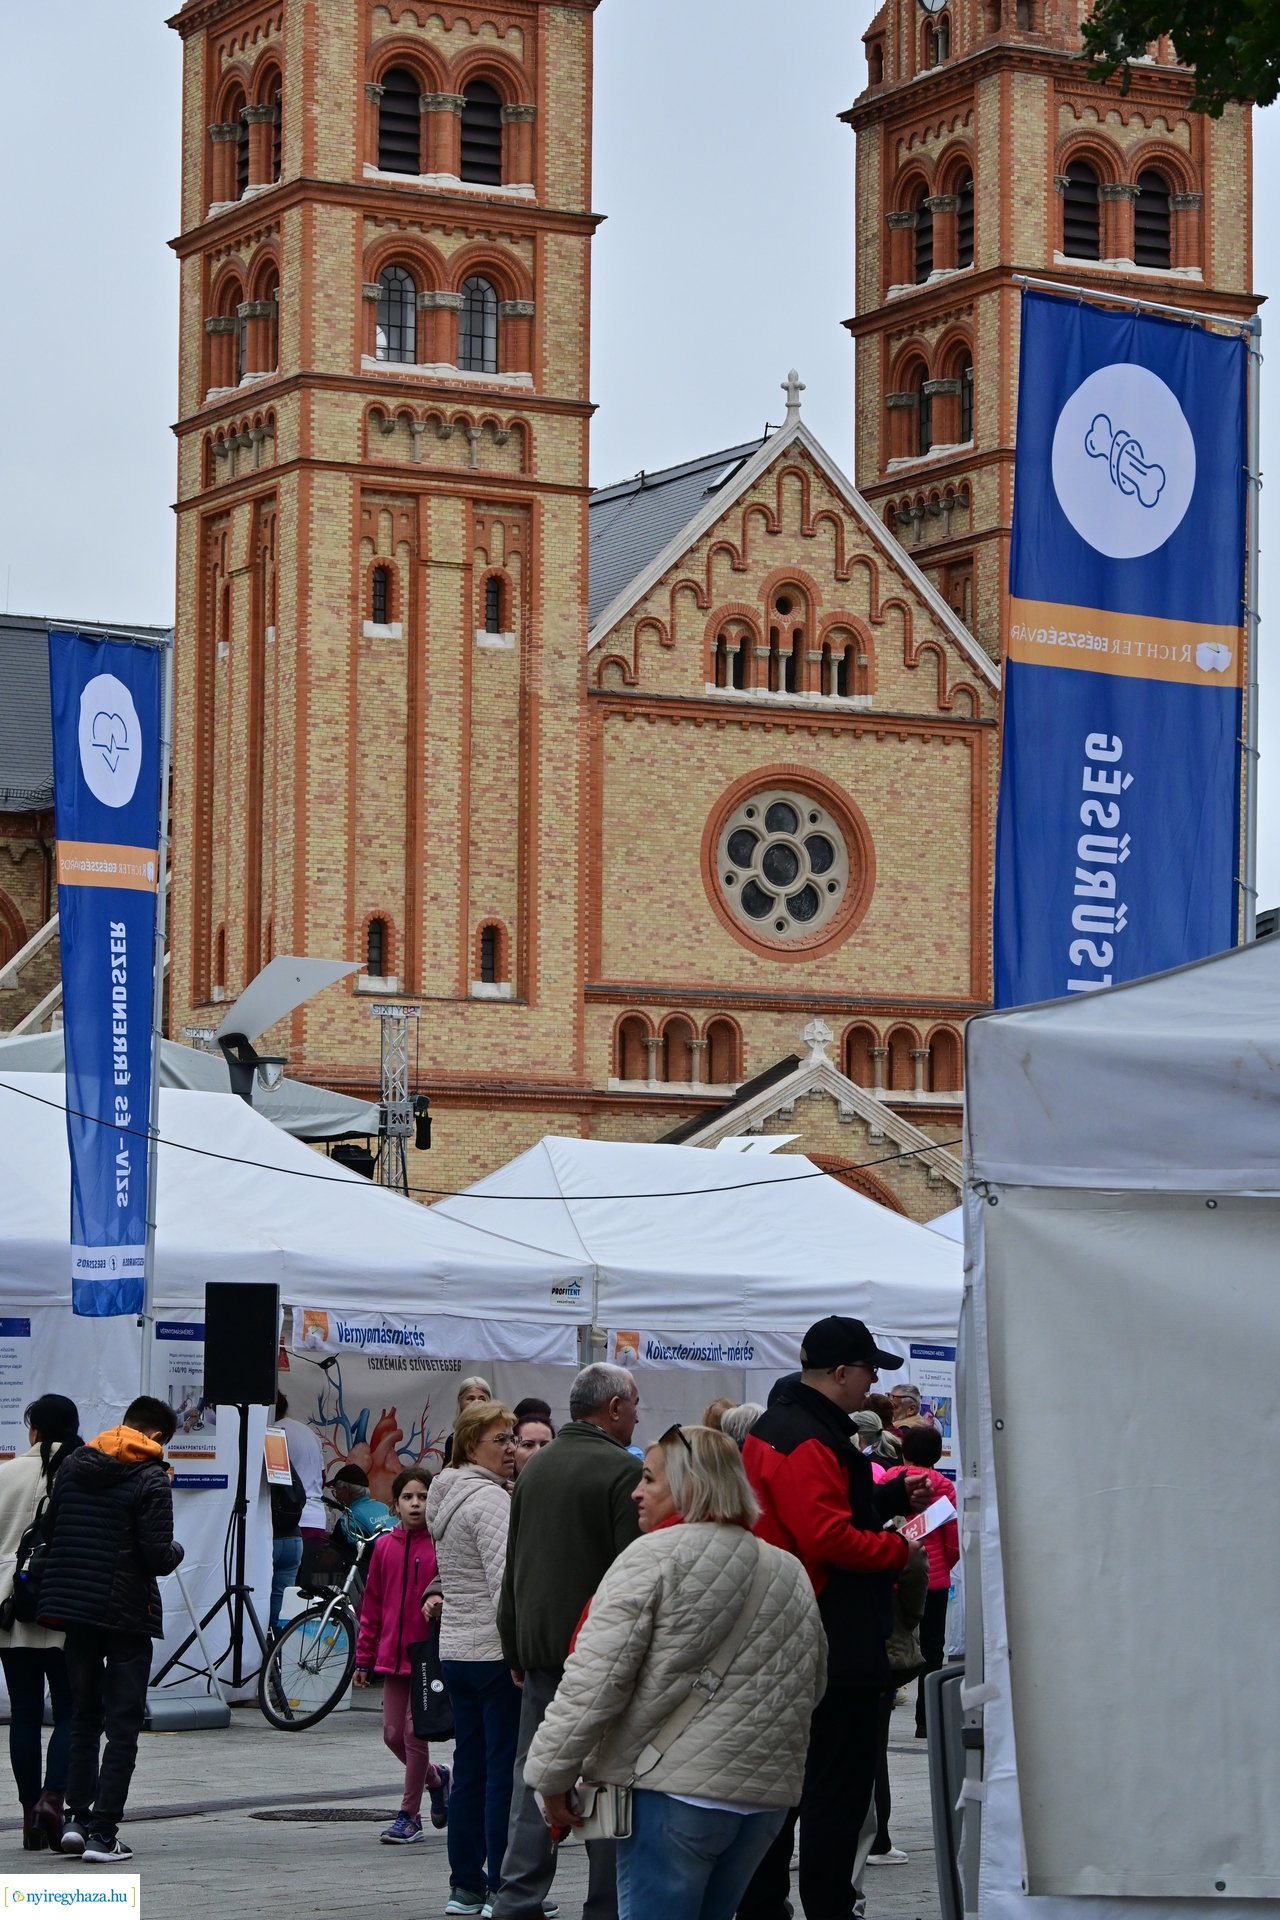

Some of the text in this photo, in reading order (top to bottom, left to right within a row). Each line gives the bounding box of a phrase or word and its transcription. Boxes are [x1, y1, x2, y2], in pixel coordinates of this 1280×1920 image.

[551, 1287, 581, 1296] PROFITENT
[336, 1321, 425, 1348] Vérnyomásmérés
[645, 1340, 754, 1362] Koleszterinszint-mérés
[368, 1355, 408, 1371] ISZKÉMIÁS
